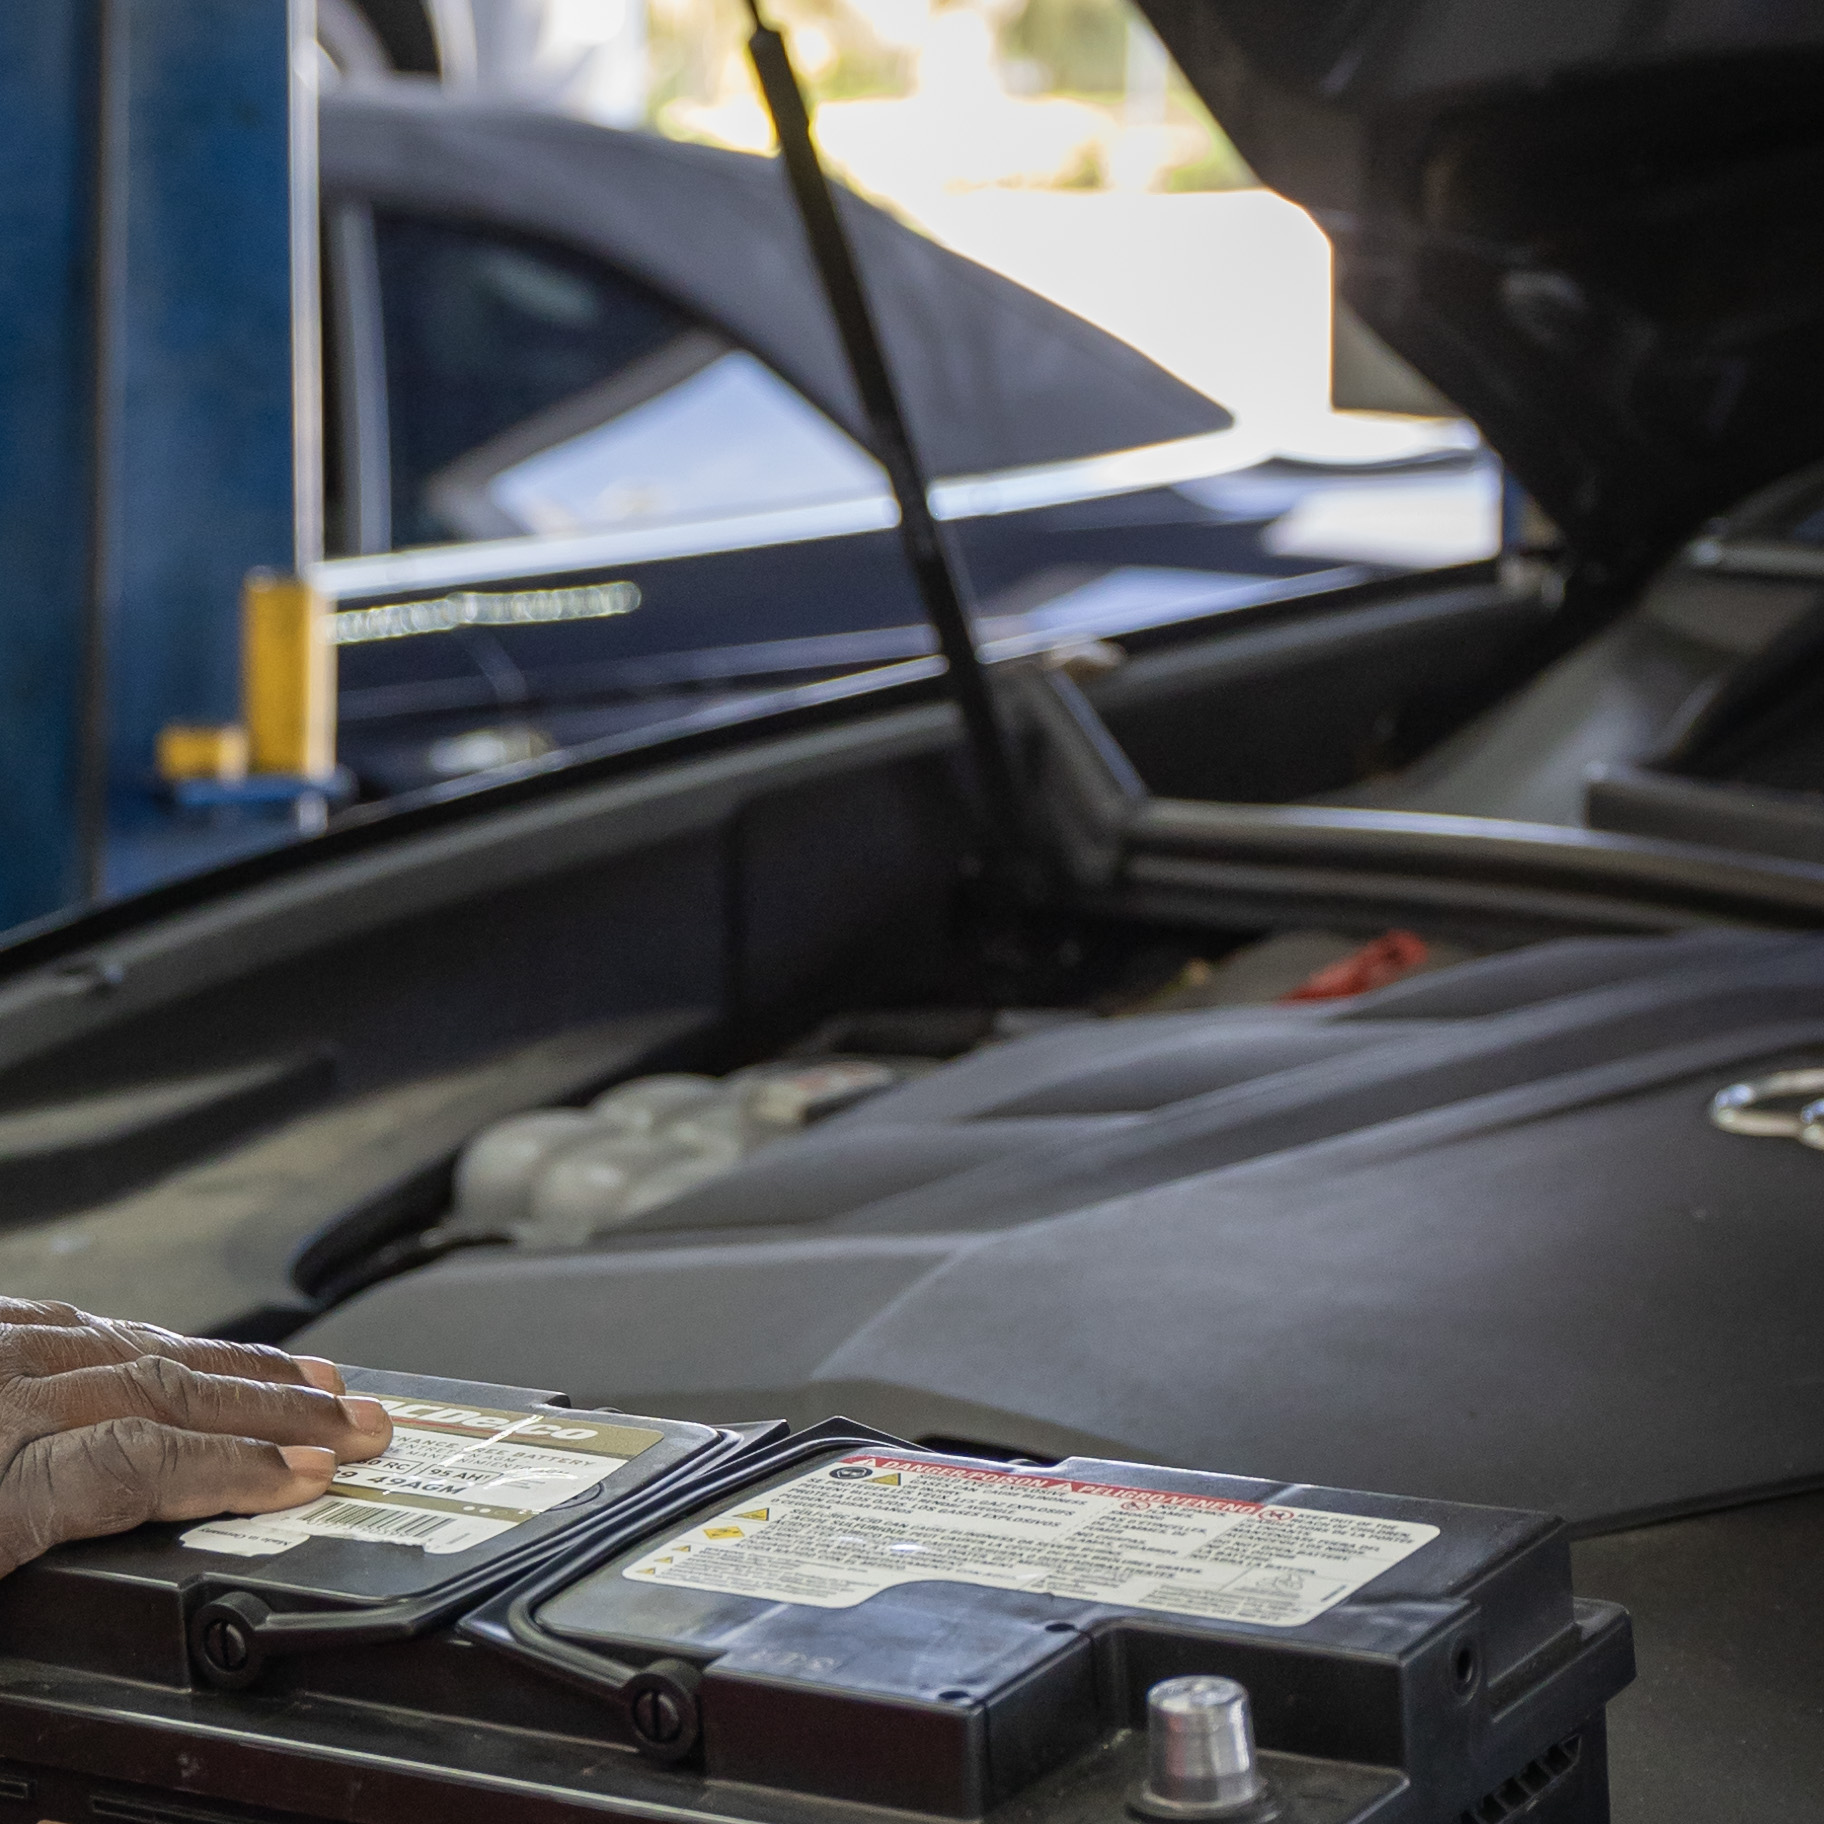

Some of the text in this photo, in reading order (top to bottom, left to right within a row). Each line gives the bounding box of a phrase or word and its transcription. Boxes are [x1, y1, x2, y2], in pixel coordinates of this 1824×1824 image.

[382, 1461, 411, 1471] RC
[512, 1451, 596, 1467] BATTERY
[429, 1468, 455, 1477] 95
[884, 1460, 1048, 1488] DANGER/POISON
[366, 1476, 468, 1495] 49AGM
[1076, 1484, 1264, 1515] PELIGRO/VENENO
